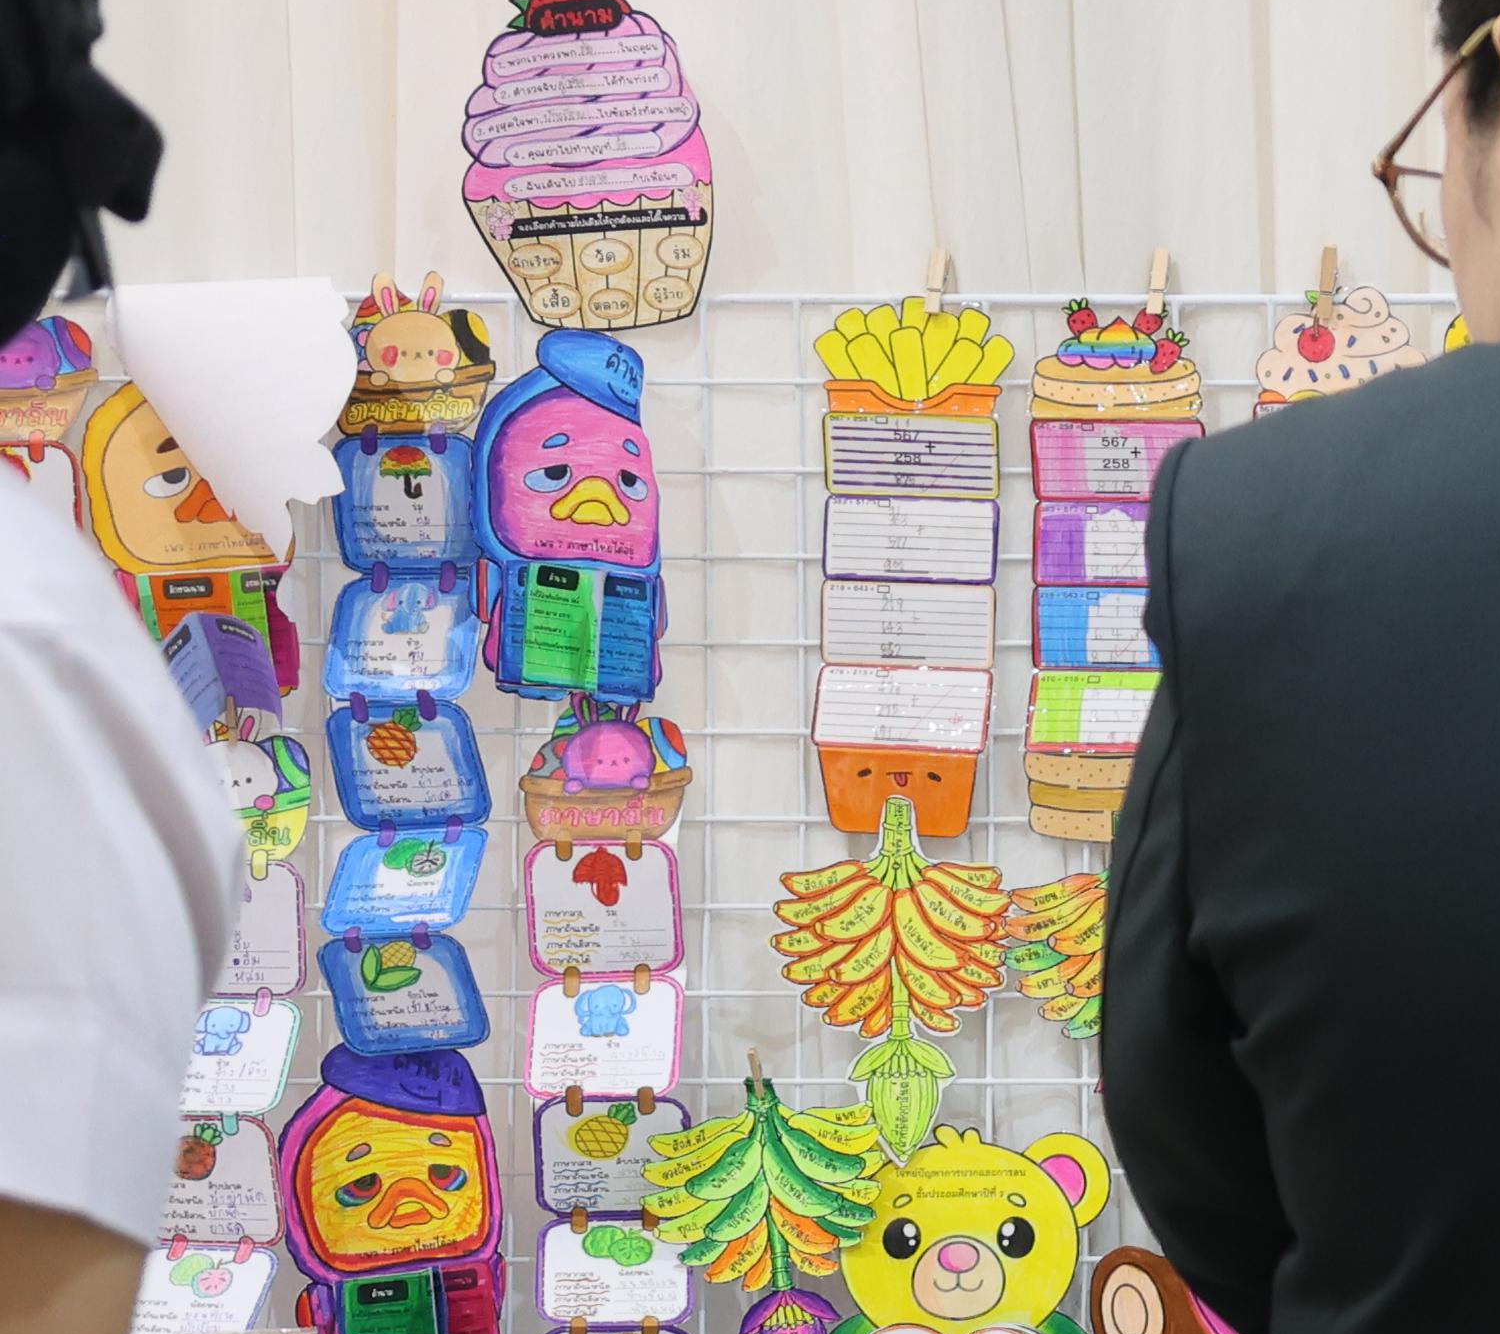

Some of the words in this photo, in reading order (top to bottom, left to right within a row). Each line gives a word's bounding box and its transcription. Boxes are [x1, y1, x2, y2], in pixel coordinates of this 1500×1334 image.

[673, 244, 692, 260] ร่ม
[894, 430, 920, 442] 567
[1102, 437, 1128, 447] 567
[894, 452, 921, 465] 258
[1102, 458, 1130, 469] 258
